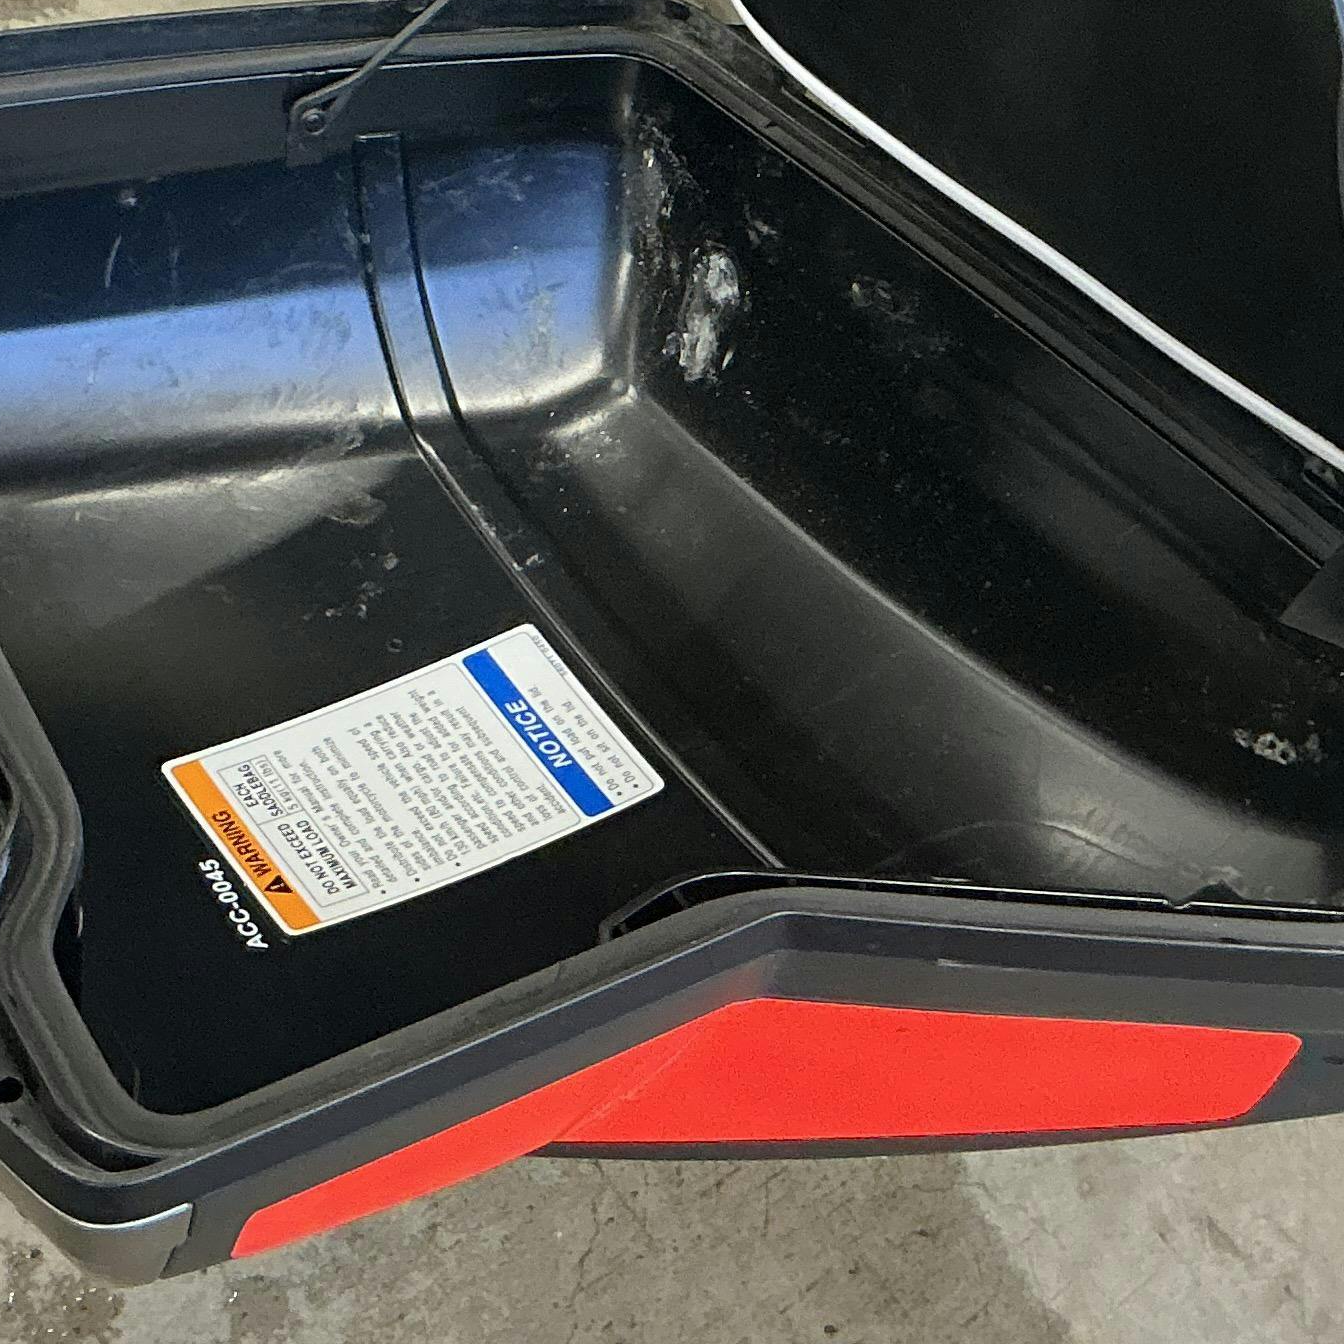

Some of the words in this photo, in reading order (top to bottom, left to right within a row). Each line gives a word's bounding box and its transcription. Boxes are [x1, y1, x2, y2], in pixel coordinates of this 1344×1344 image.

[502, 697, 574, 770] NOTICE
[231, 782, 259, 808] EACH
[235, 763, 285, 817] SADDLEBAG
[209, 808, 274, 877] WARNING
[275, 821, 313, 859] EXCEED
[294, 819, 323, 846] LOAD
[305, 859, 329, 879] NOT
[315, 845, 357, 889] MAXIMUM
[321, 879, 340, 894] DO
[198, 859, 270, 949] ACC-0045
